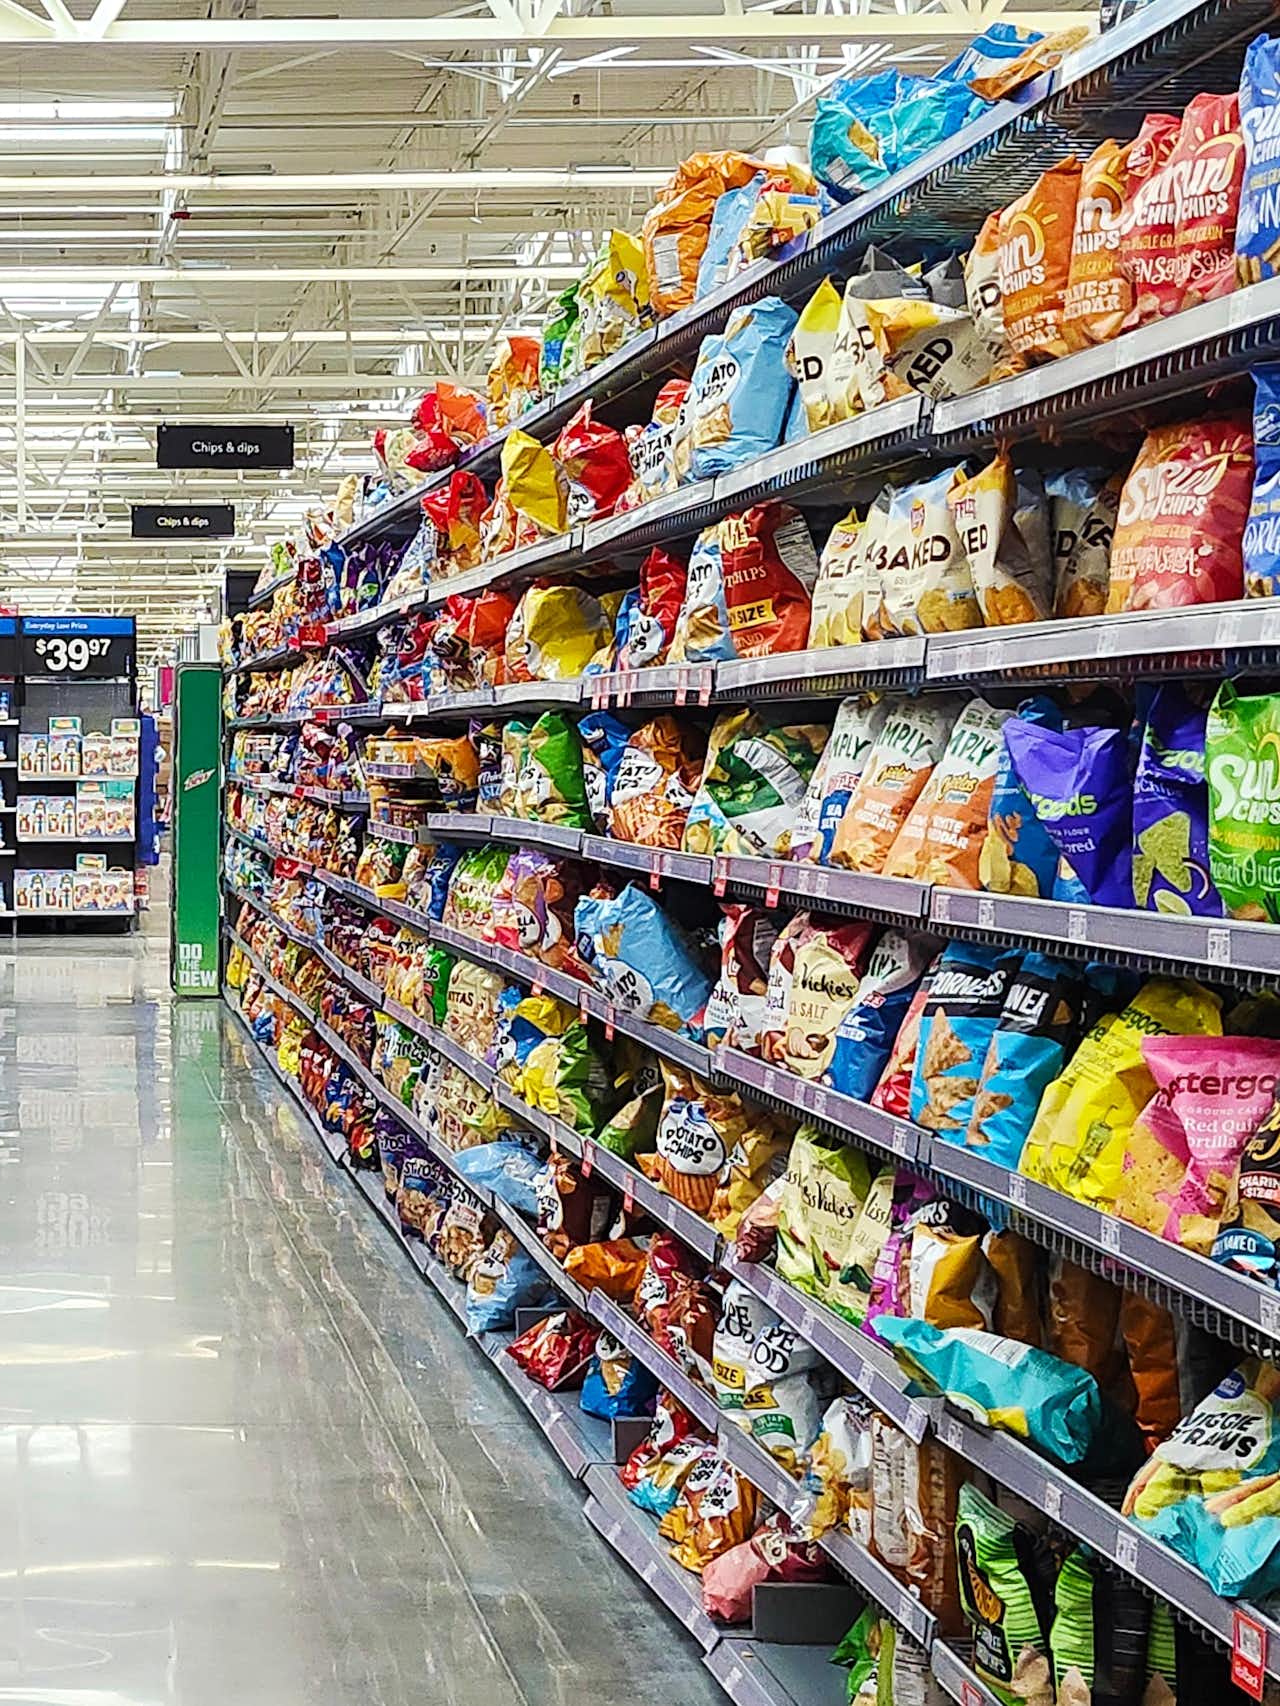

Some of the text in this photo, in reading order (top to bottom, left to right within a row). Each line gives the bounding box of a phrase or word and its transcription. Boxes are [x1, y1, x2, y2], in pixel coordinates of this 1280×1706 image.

[1182, 192, 1229, 221] CHIPS
[1075, 230, 1120, 254] HIPS
[1003, 265, 1045, 295] CHIPS
[906, 338, 953, 393] KED
[192, 441, 260, 455] Chips & dips
[1162, 495, 1207, 516] CHIPS
[156, 516, 209, 528] Chips & dips
[875, 534, 951, 571] BAKED
[689, 563, 713, 582] ATO
[738, 605, 765, 624] SIZE
[25, 622, 55, 631] Everyday
[877, 721, 933, 758] MPLY
[179, 944, 202, 960] DO
[181, 960, 200, 970] THE
[179, 971, 216, 986] DEW
[801, 962, 855, 1001] Vickie's
[800, 1003, 828, 1021] SALT
[1185, 1117, 1257, 1135] Red Qui
[666, 1126, 716, 1151] POTATO
[1187, 1135, 1238, 1149] ortilla
[664, 1140, 704, 1164] CHIPS
[1240, 1176, 1280, 1190] SHARIN
[765, 1327, 795, 1355] PE
[754, 1342, 789, 1373] OD
[717, 1364, 738, 1383] SIZE
